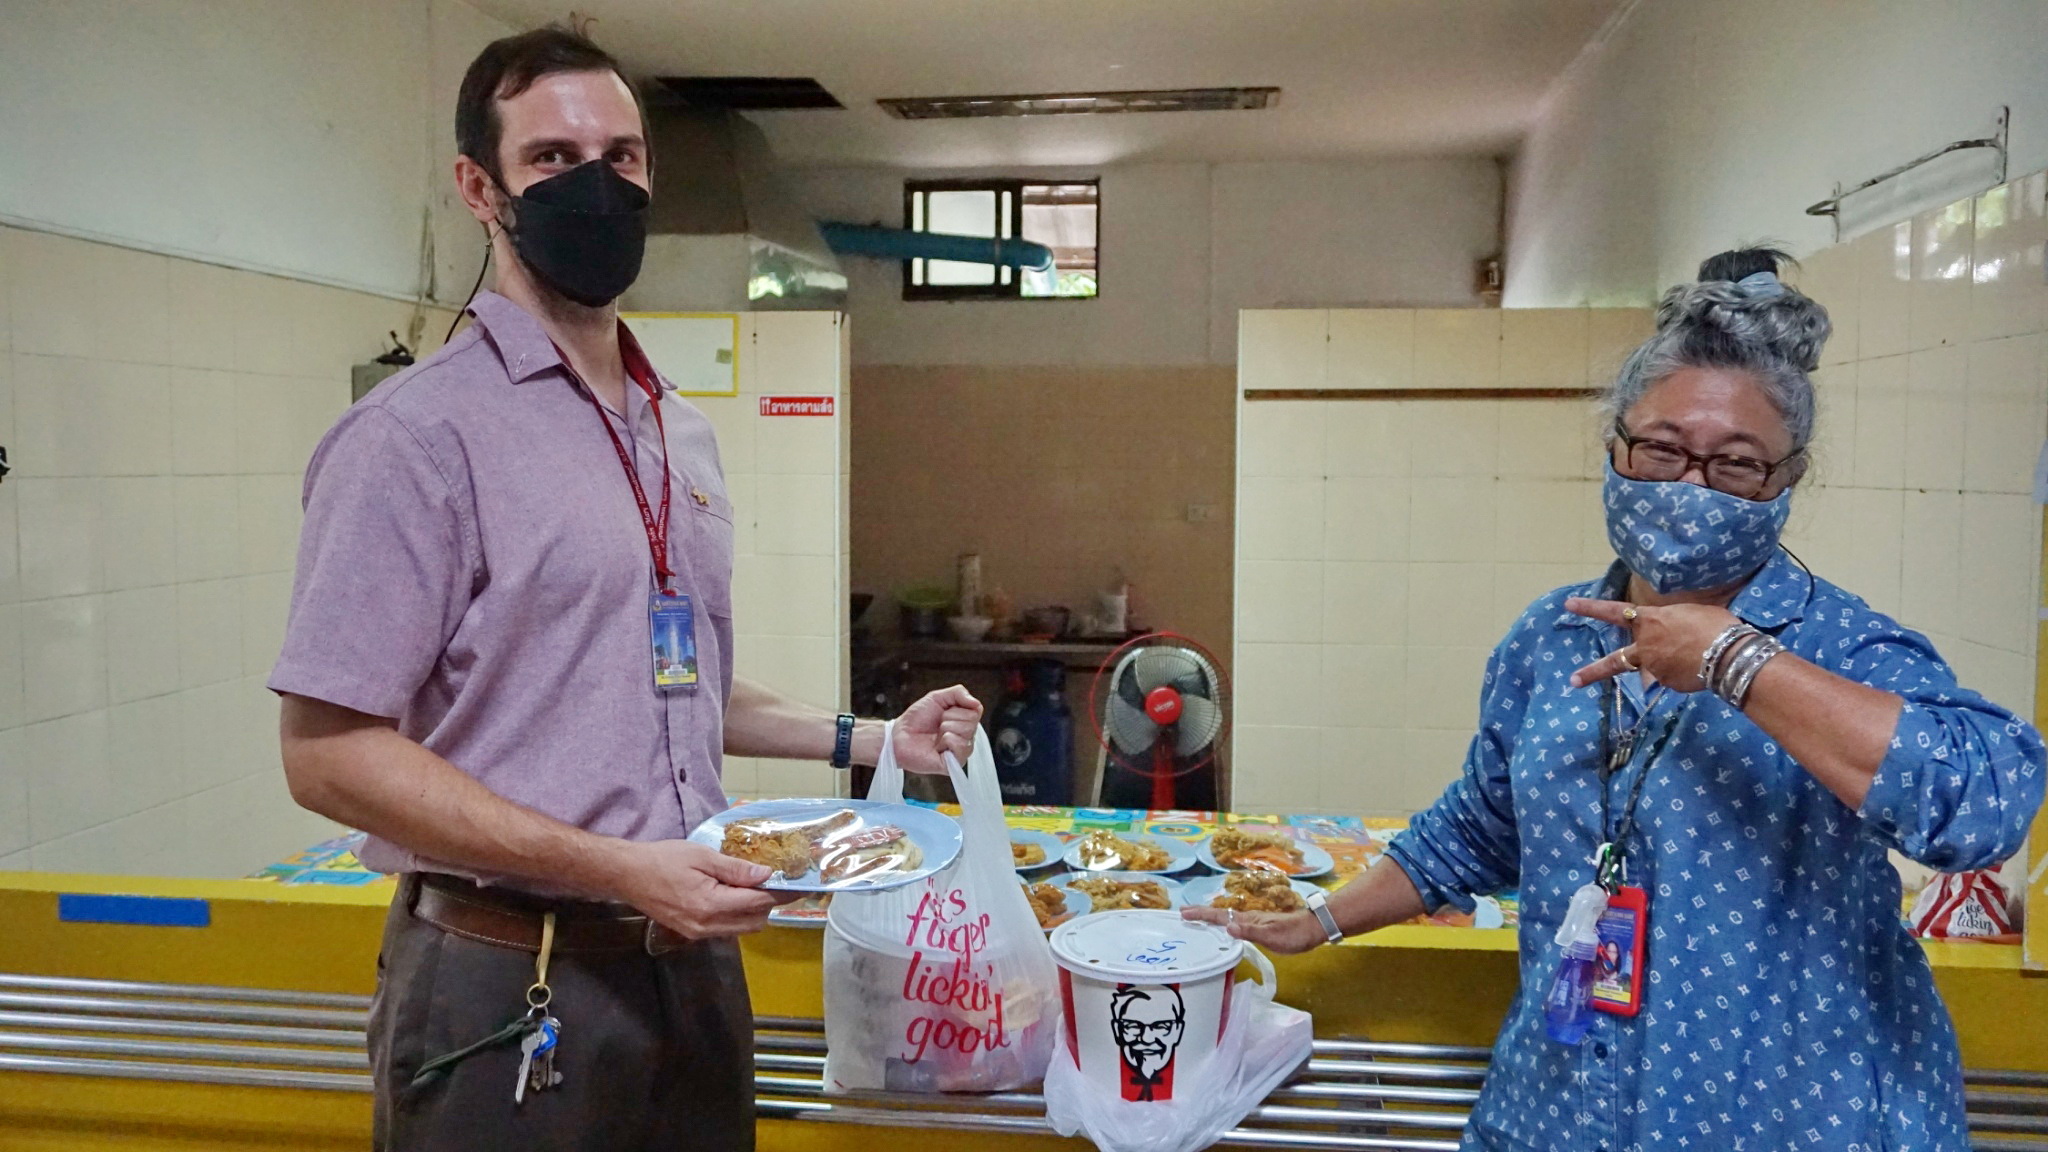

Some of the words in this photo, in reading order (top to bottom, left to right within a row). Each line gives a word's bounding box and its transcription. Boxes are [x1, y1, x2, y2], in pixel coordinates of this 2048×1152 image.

[771, 397, 832, 414] อาหารตามสั่ง
[625, 464, 645, 504] International
[643, 507, 652, 525] Mary
[658, 503, 668, 541] International
[902, 994, 1011, 1065] good
